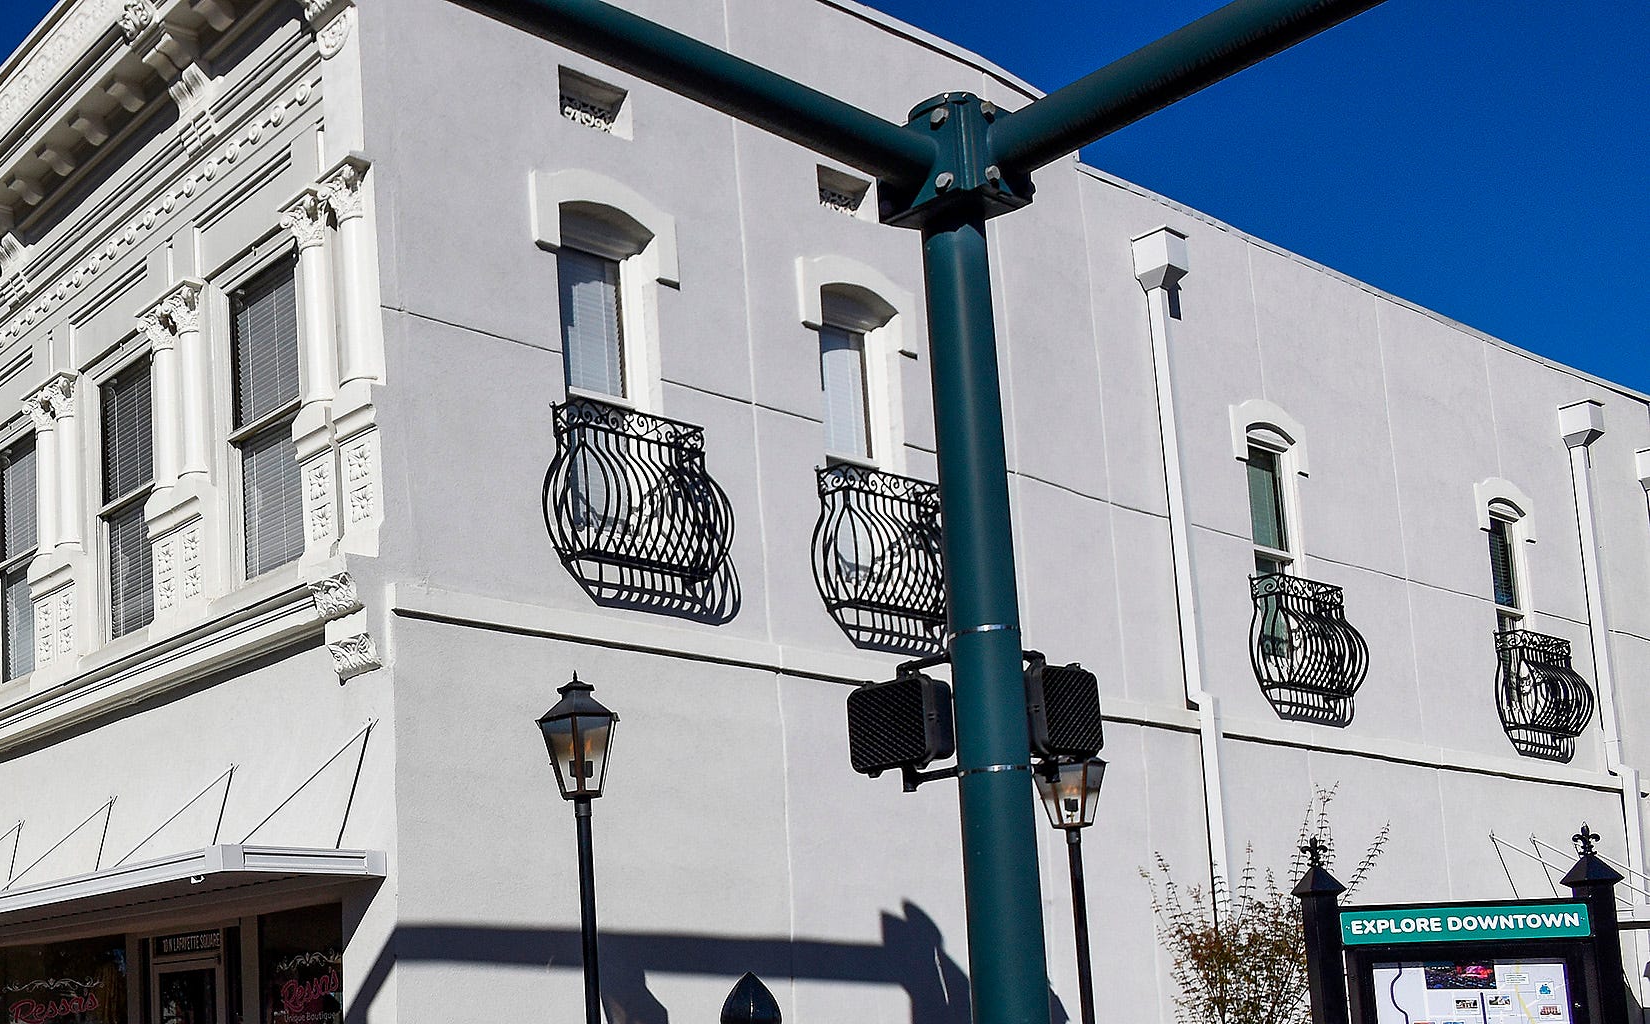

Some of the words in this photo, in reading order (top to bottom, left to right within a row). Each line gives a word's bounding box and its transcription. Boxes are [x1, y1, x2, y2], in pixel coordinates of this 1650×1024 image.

[1351, 917, 1442, 935] EXPLORE
[1447, 912, 1580, 931] DOWNTOWN
[173, 935, 199, 952] LAFAYETTE
[200, 933, 220, 949] SQUARE
[281, 966, 339, 1012] Ressa's
[9, 988, 99, 1024] Ressa's
